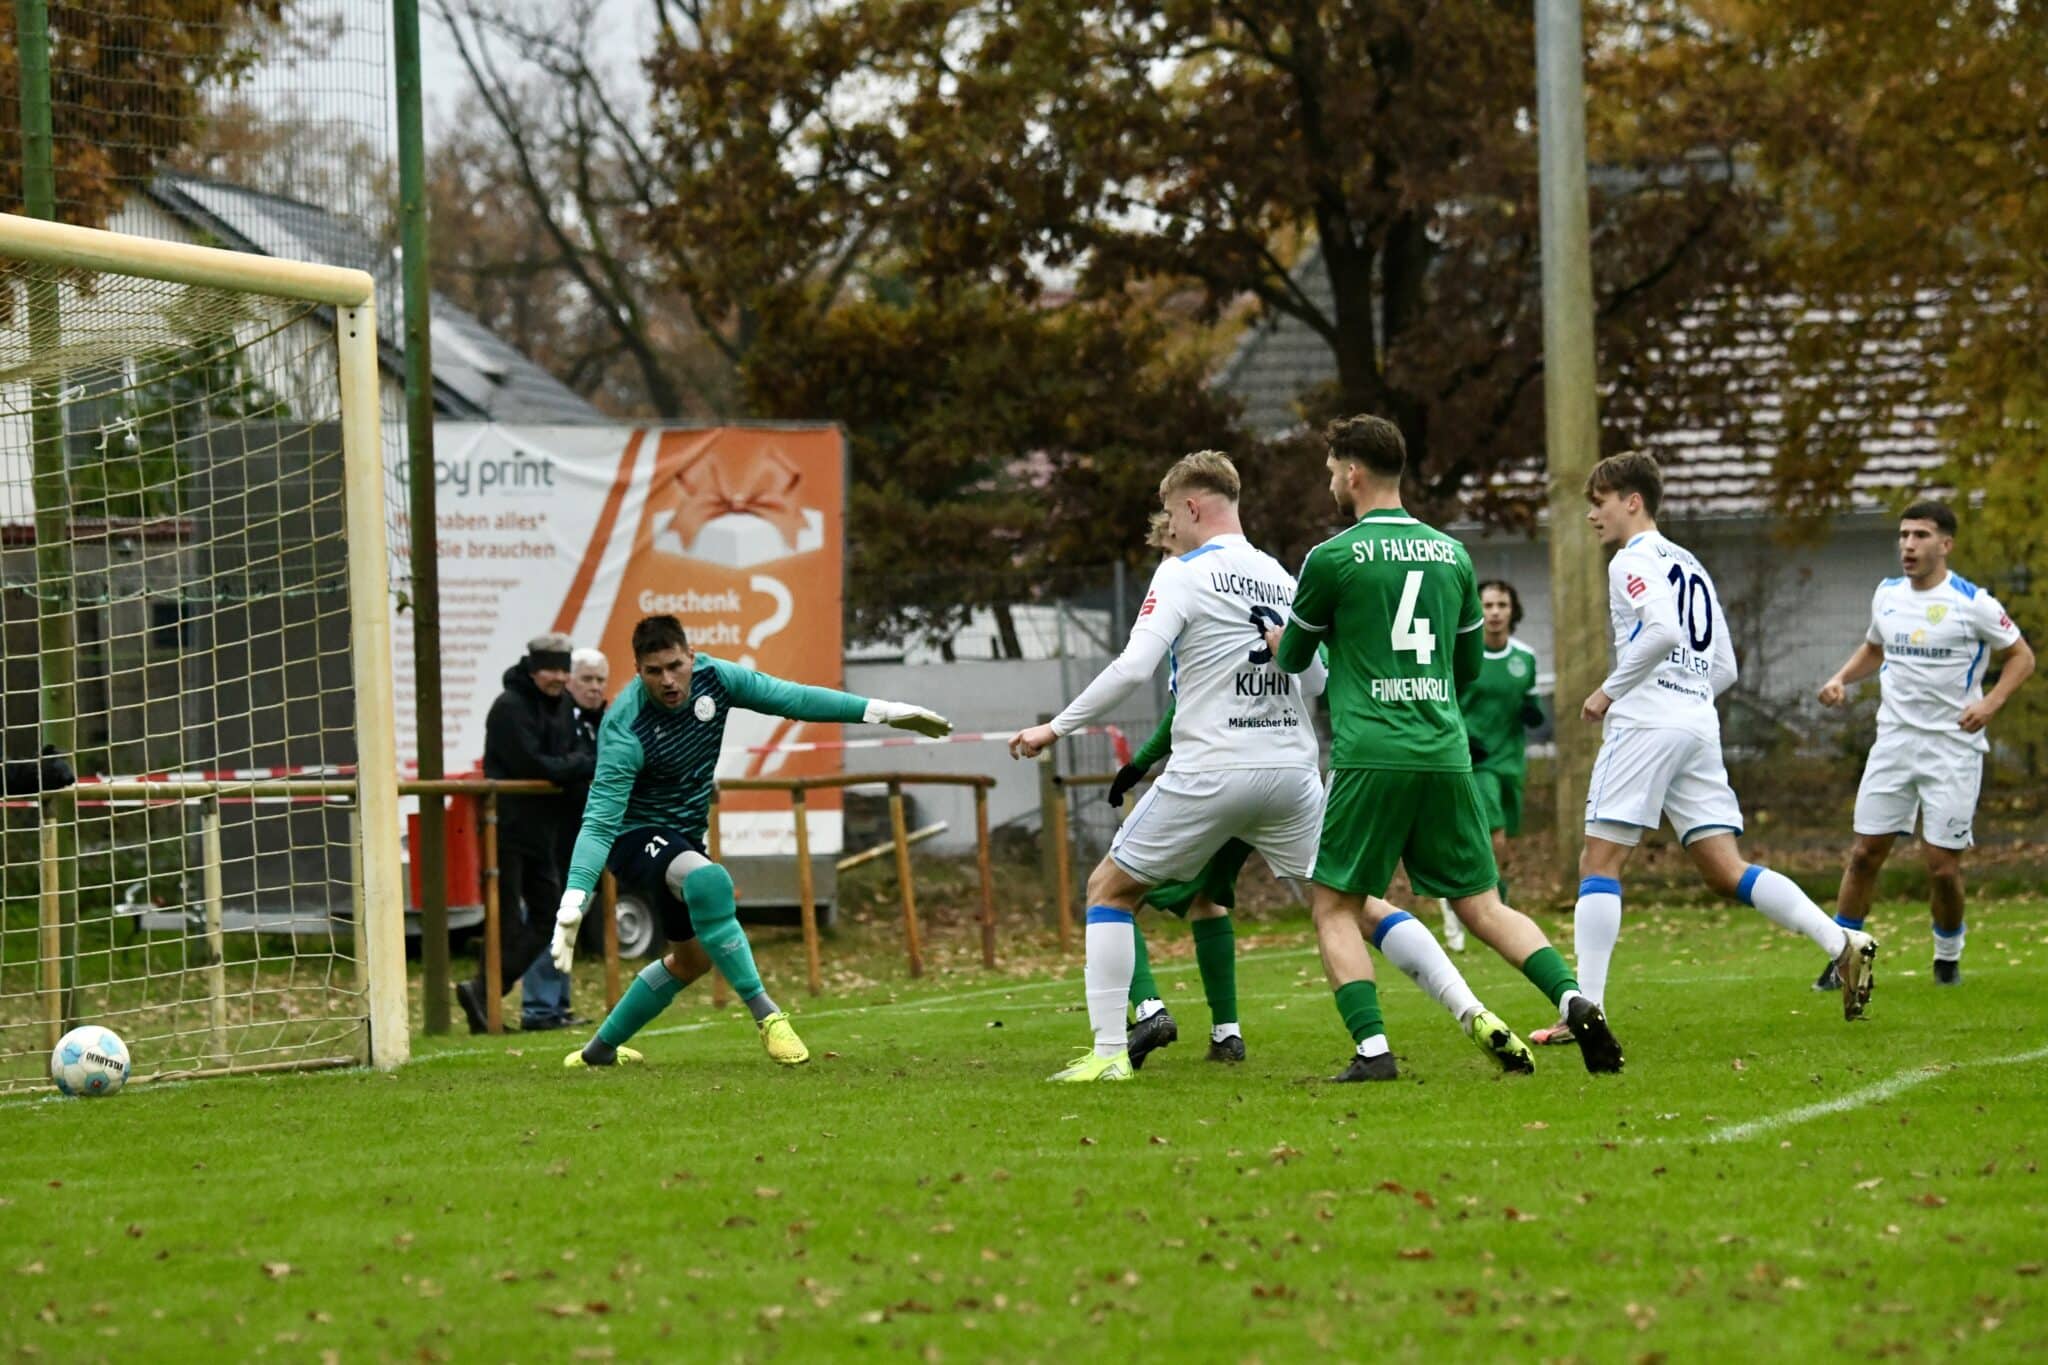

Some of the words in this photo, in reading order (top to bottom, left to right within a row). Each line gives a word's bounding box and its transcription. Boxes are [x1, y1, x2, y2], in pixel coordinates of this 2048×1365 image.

[394, 459, 470, 497] cpy
[479, 451, 555, 497] print
[468, 540, 556, 558] brauchen
[1352, 539, 1375, 564] SV
[1380, 538, 1457, 565] FALKENSEE
[638, 589, 741, 614] Geschenk
[1211, 572, 1293, 607] LUCKENWAL
[1391, 570, 1436, 665] 4
[1667, 563, 1713, 652] 10
[1236, 667, 1290, 697] KÜHN
[1371, 677, 1451, 703] FINKENKRU
[1228, 717, 1282, 728] Märkischer
[644, 835, 669, 858] 21
[86, 1052, 124, 1072] DERBYSTAR
